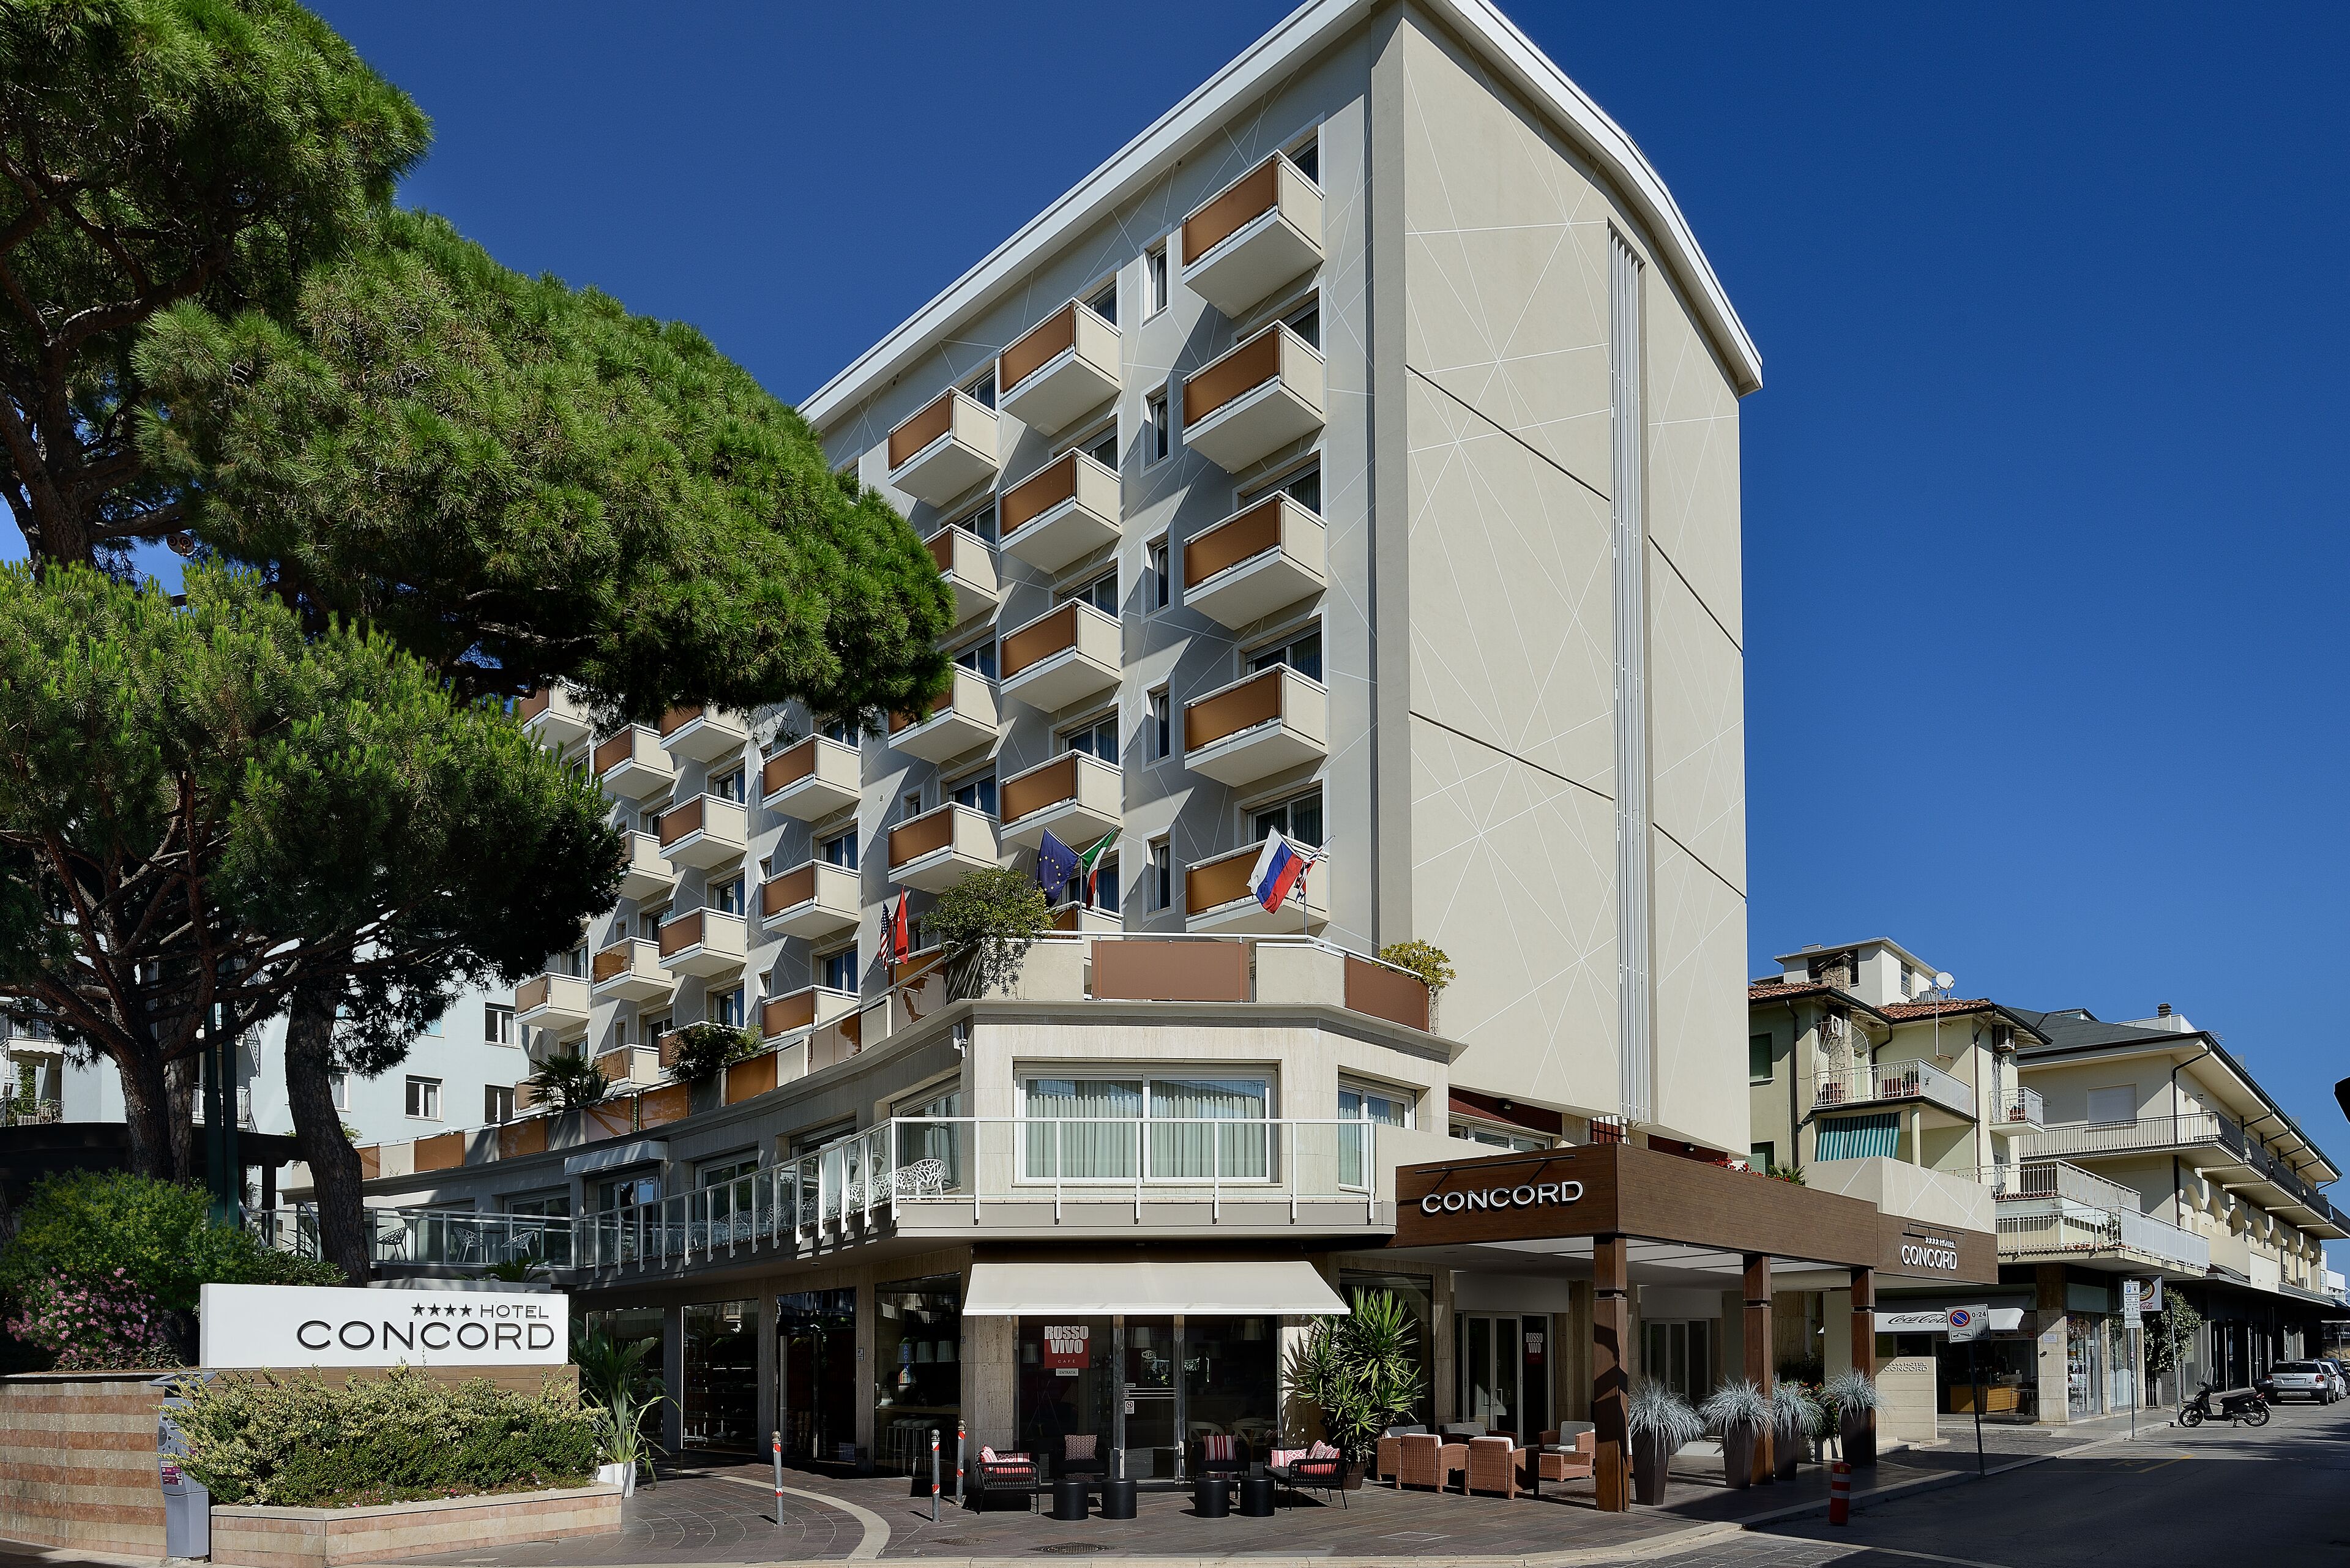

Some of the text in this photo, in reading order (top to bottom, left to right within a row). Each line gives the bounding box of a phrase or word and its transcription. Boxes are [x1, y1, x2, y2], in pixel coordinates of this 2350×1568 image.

[1422, 1181, 1583, 1213] CONCORD
[1939, 1239, 1956, 1249] HOTEL
[1901, 1245, 1957, 1269] CONCORD
[480, 1304, 549, 1319] HOTEL
[296, 1320, 554, 1351] CONCORD
[1045, 1326, 1089, 1340] ROSSO
[1526, 1332, 1543, 1343] ROSSO
[1050, 1339, 1084, 1354] VIVO
[1528, 1343, 1541, 1353] VIVO
